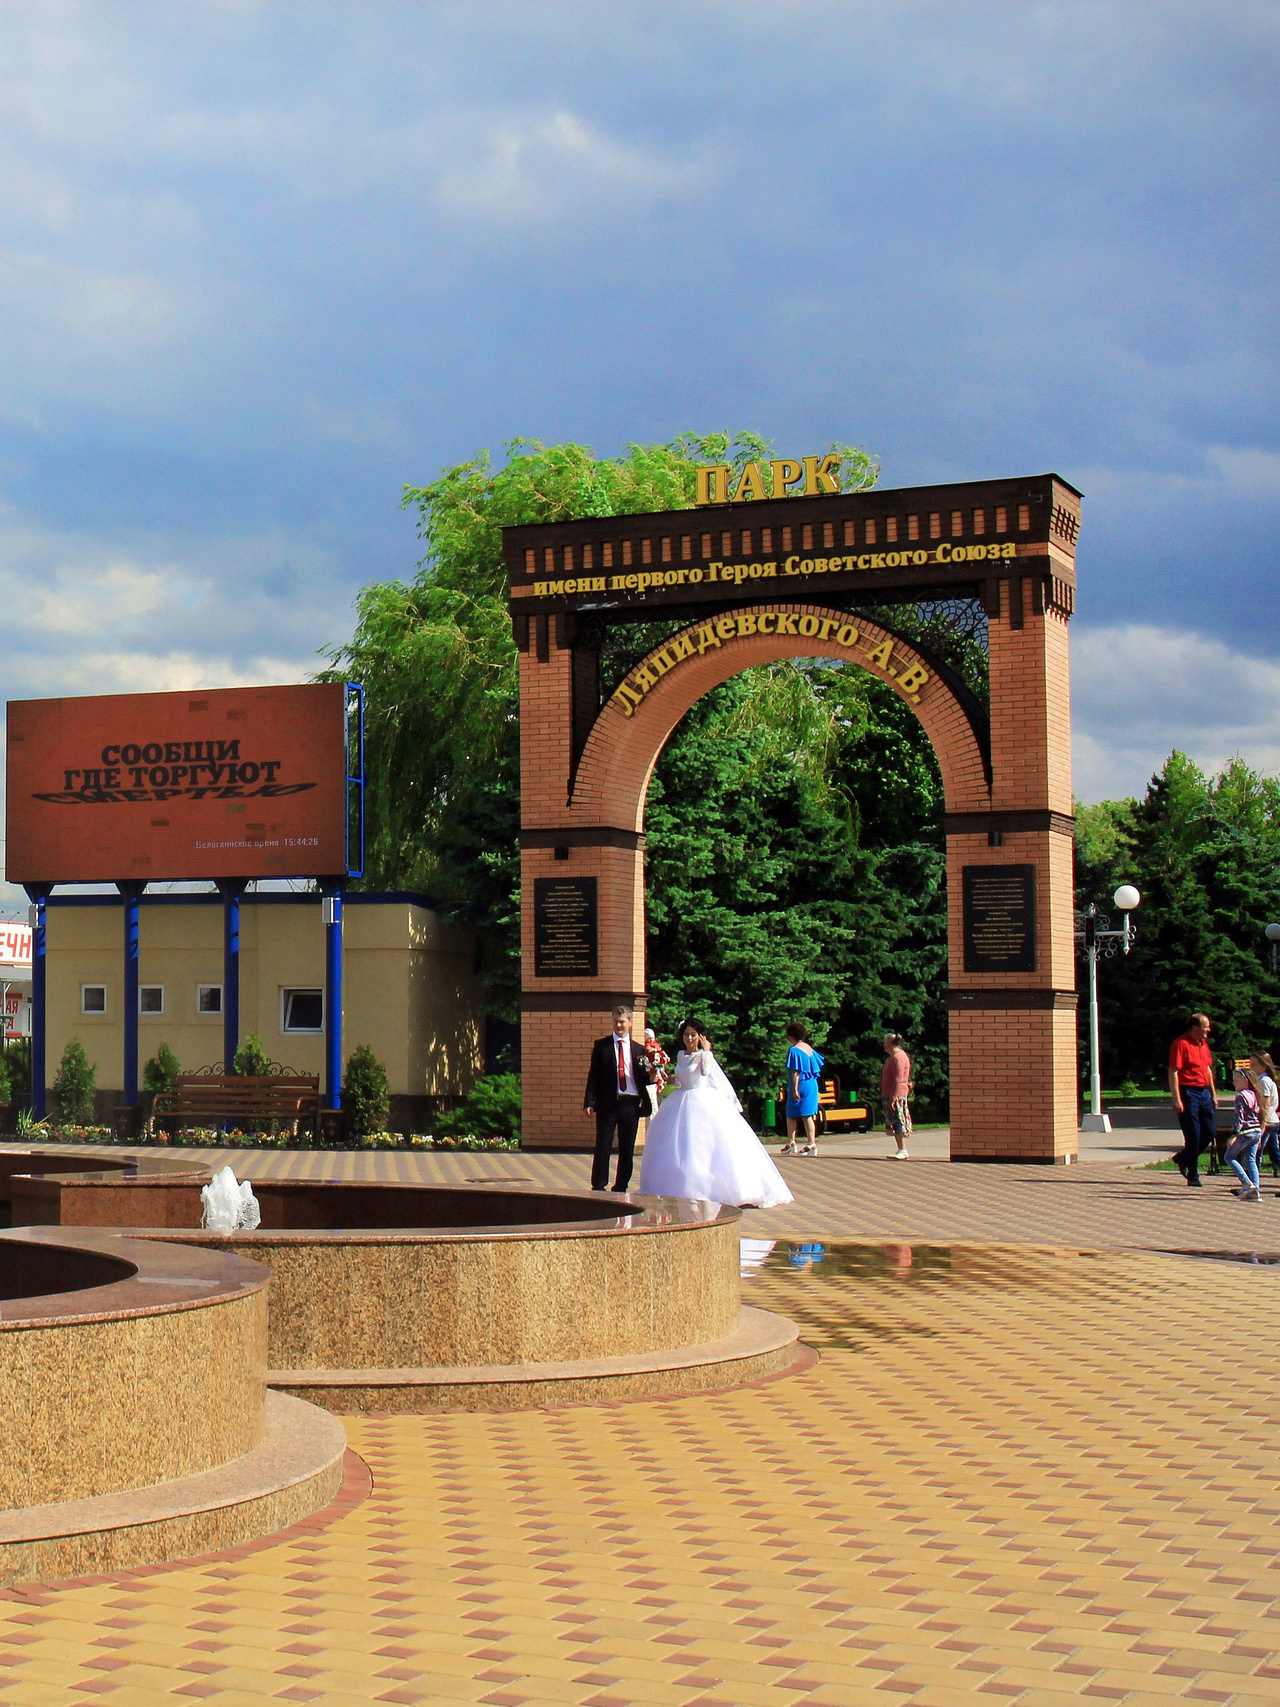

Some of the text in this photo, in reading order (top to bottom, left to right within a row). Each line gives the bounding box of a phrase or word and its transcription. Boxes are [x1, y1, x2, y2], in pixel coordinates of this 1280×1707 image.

[694, 454, 842, 505] ПАРК
[533, 543, 1017, 596] имени первого Героя Советского Союза
[613, 612, 859, 716] Ляпидевского
[101, 740, 240, 766] СООБЩИ
[32, 783, 318, 804] СМЕРТЬЮ
[64, 762, 281, 792] ГДЕ ТОРГУЮТ
